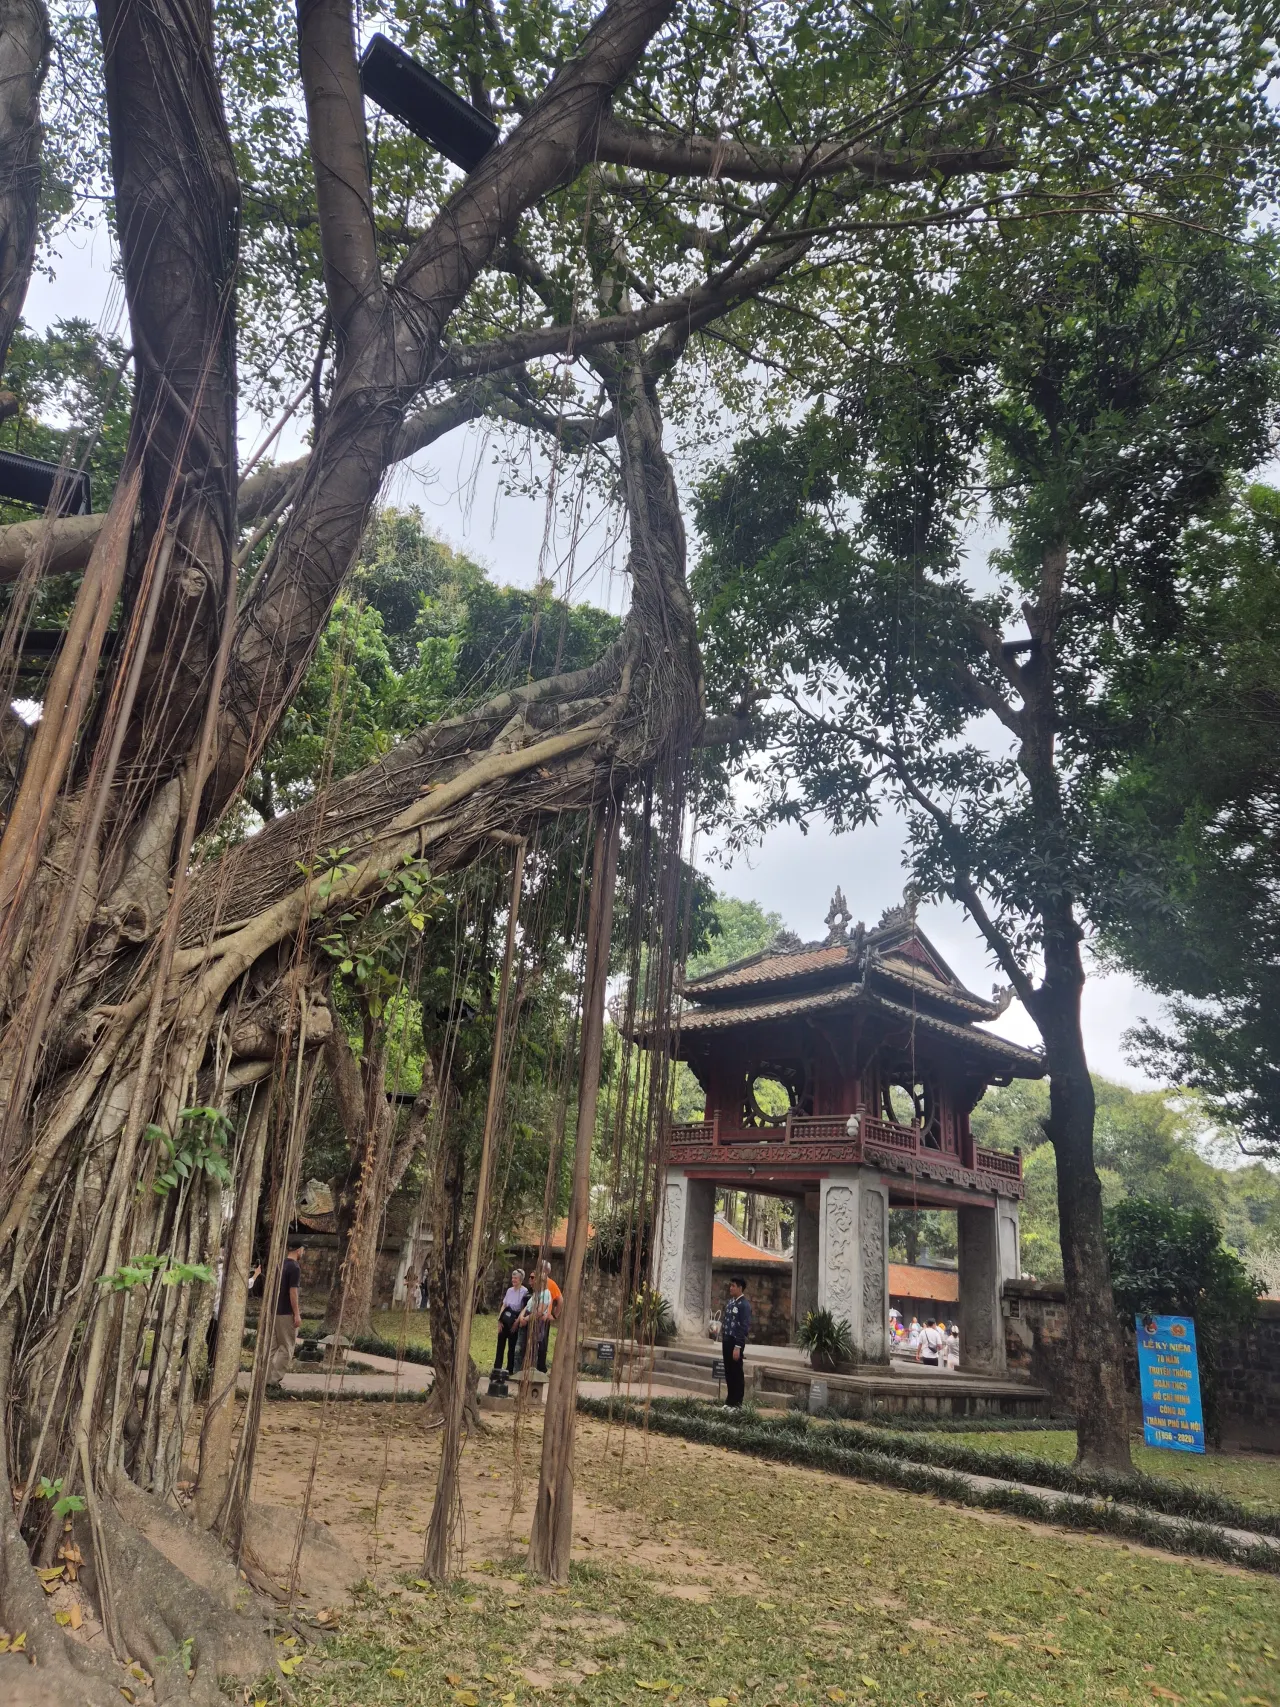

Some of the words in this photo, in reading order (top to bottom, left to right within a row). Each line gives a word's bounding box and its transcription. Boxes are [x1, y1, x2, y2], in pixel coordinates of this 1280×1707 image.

[1157, 1354, 1164, 1363] 70
[1159, 1404, 1176, 1415] CÔNG
[1177, 1407, 1186, 1416] AN
